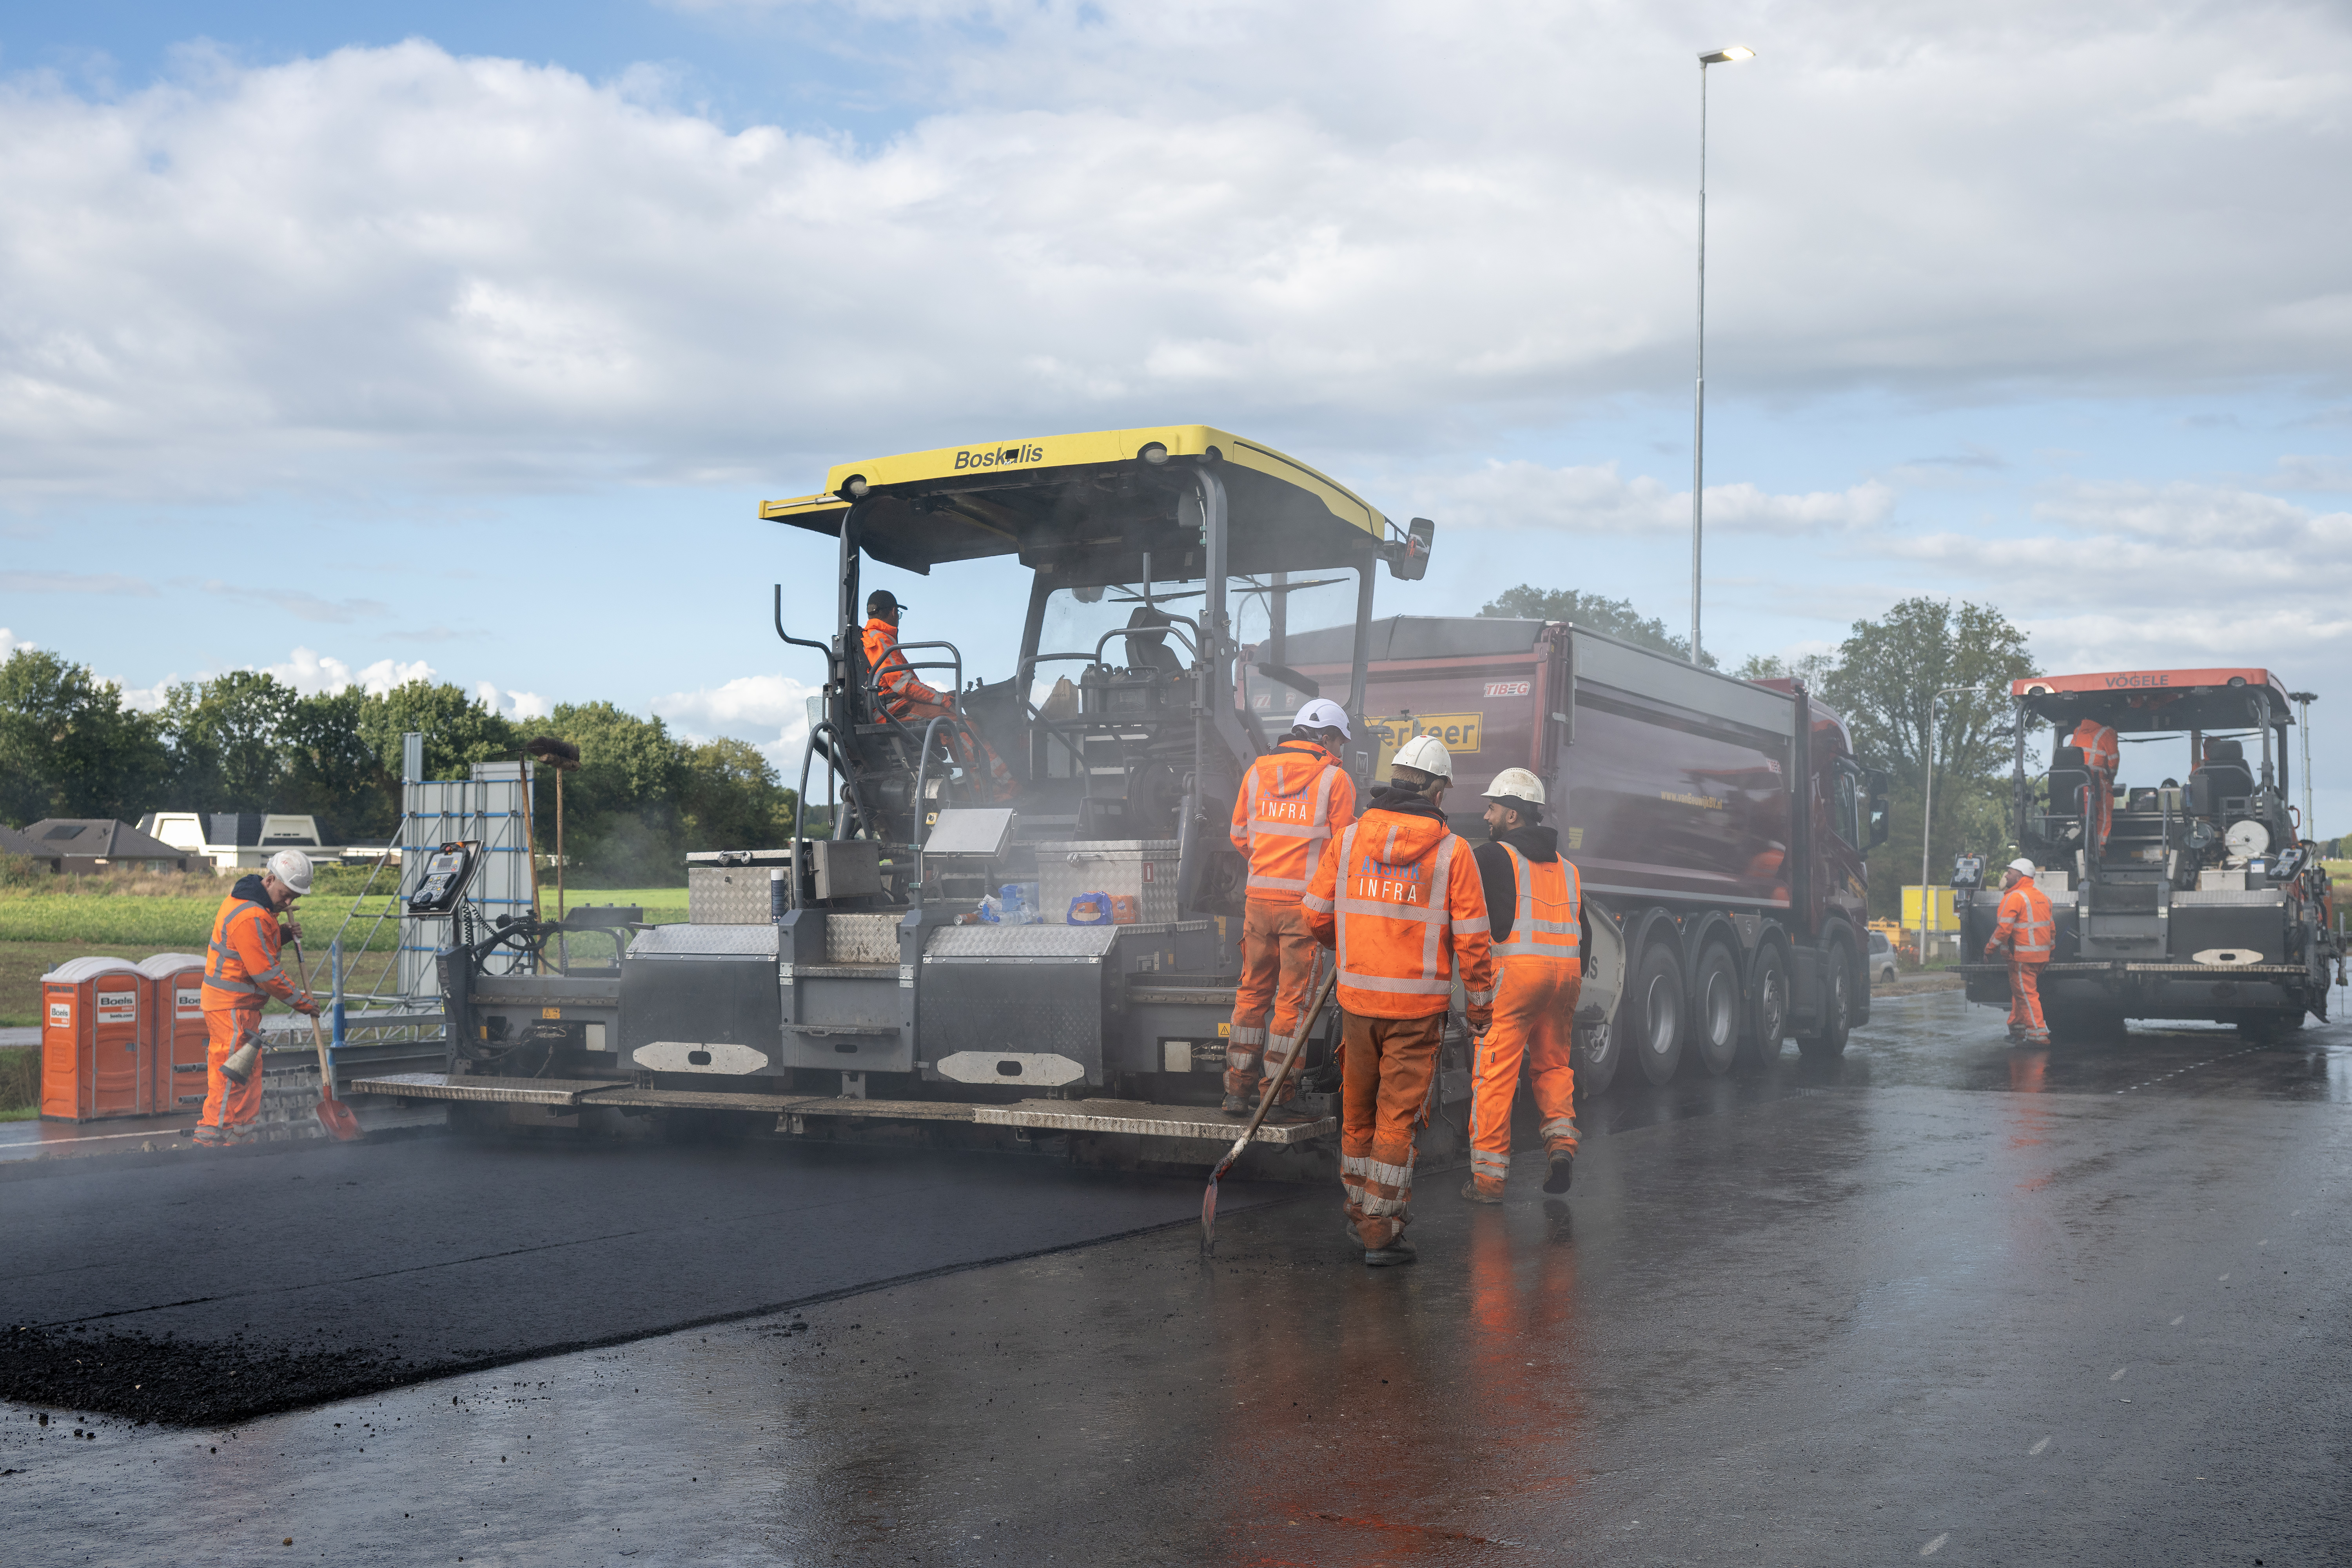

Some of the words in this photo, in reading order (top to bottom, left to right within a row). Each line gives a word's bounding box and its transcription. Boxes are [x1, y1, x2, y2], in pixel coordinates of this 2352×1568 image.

[954, 444, 1043, 469] Bosklis
[1486, 683, 1528, 695] TIBEG
[2105, 673, 2169, 688] VÖGELE
[1254, 694, 1294, 706] TIG
[1262, 801, 1306, 820] INFRA
[1361, 856, 1421, 880] ANSINK
[1359, 878, 1416, 902] INFRA
[51, 1008, 68, 1017] Boels
